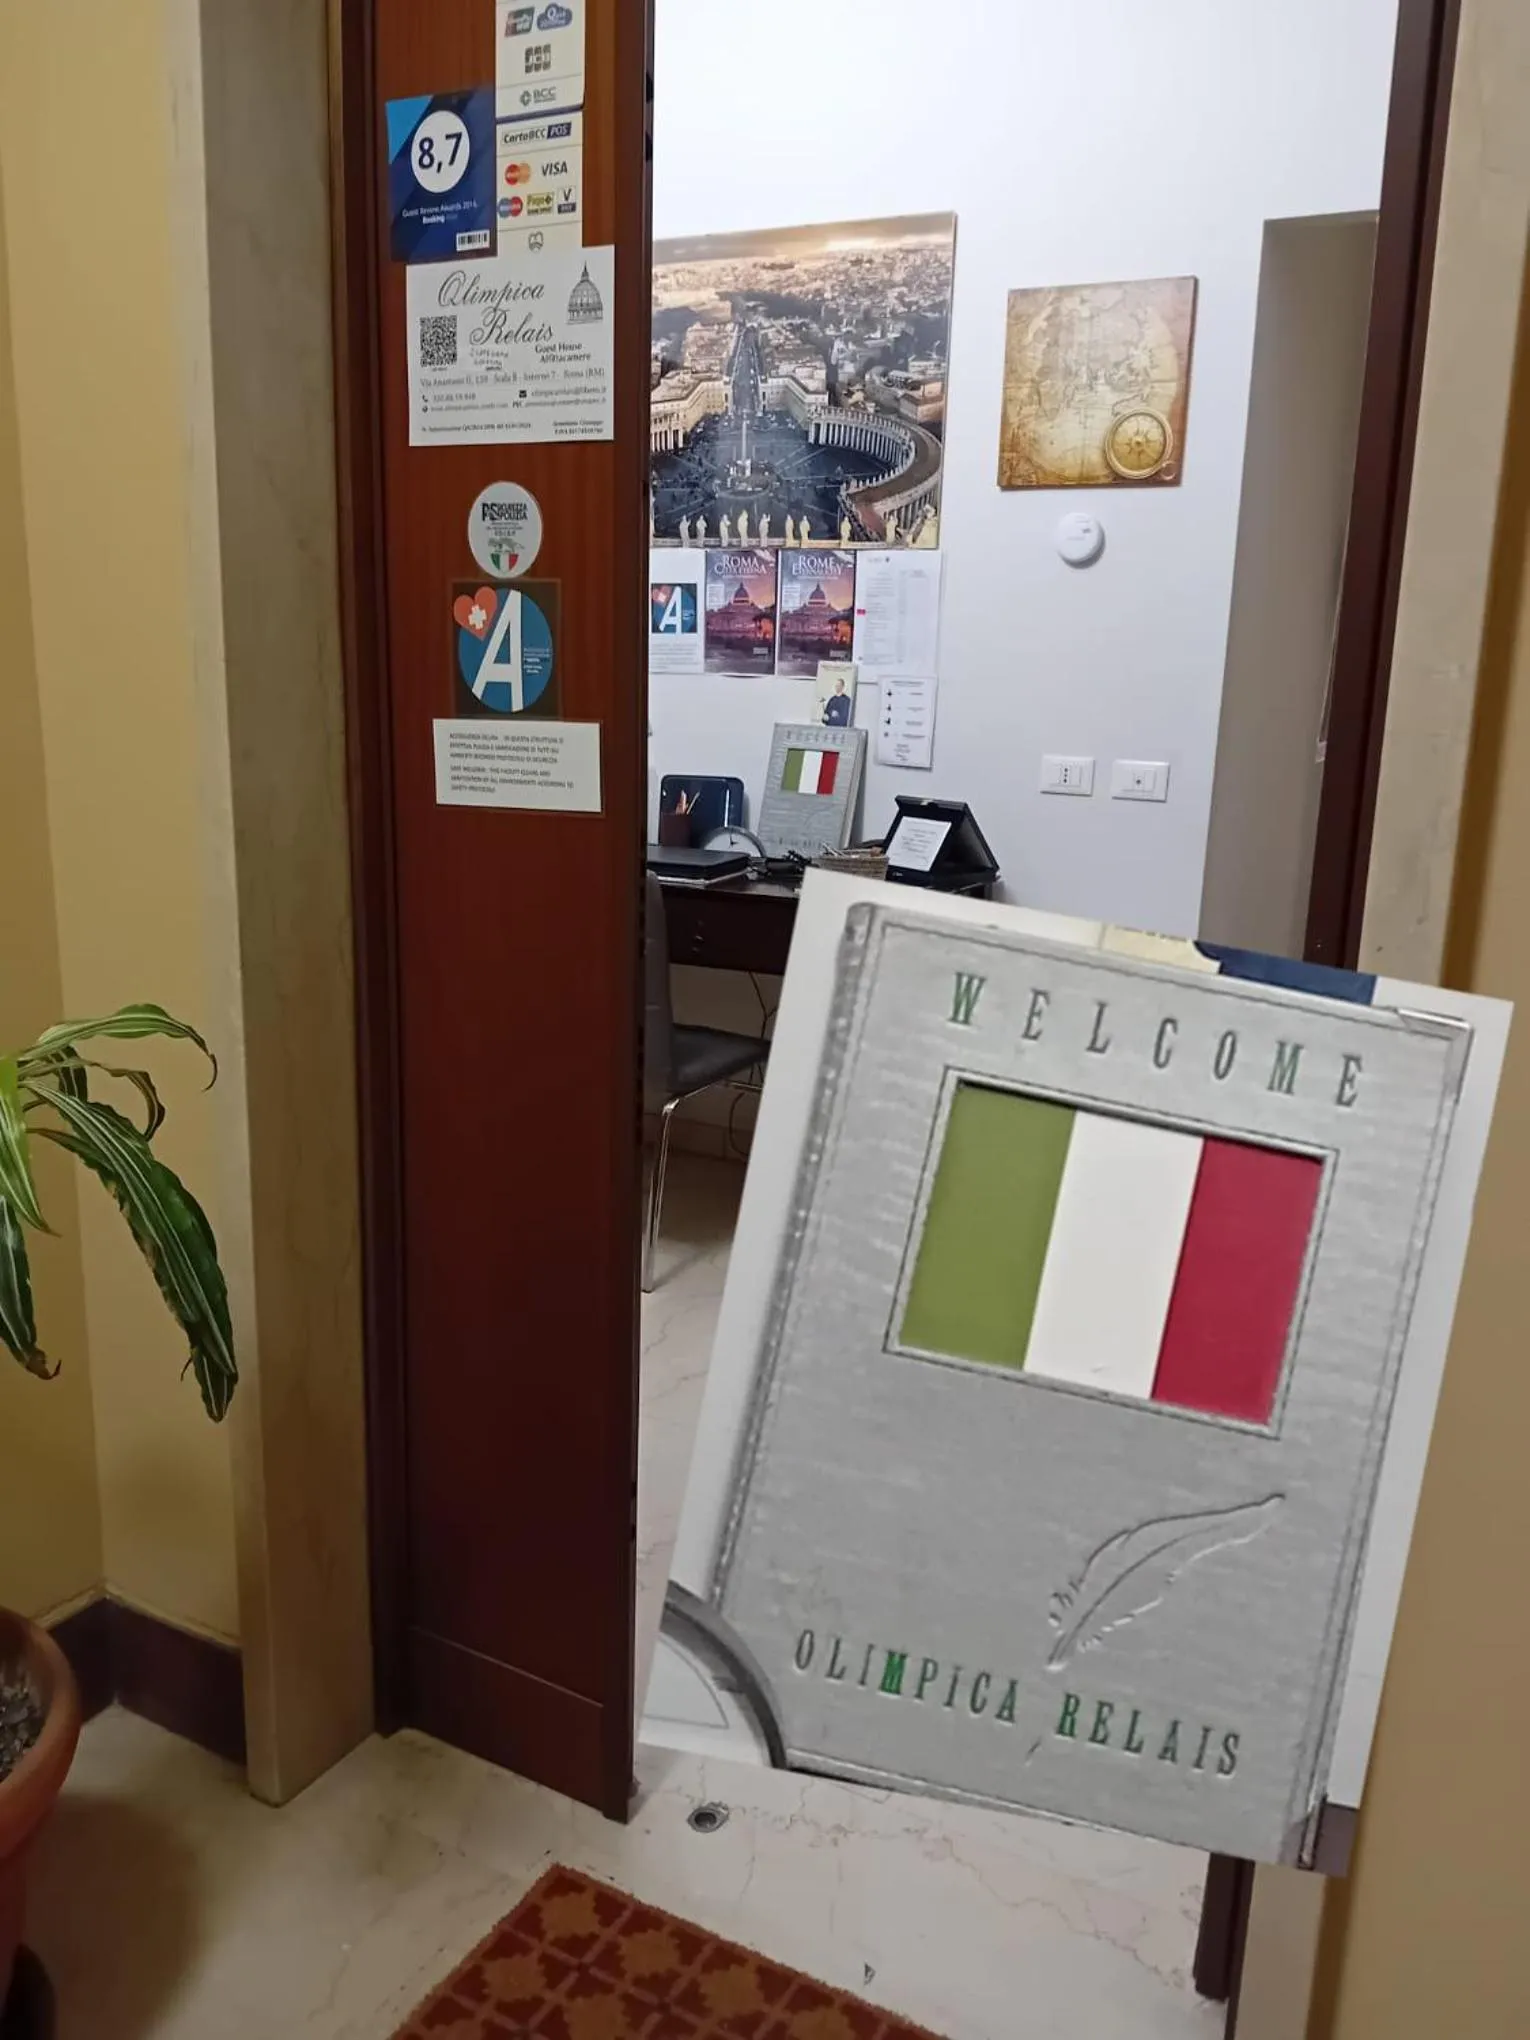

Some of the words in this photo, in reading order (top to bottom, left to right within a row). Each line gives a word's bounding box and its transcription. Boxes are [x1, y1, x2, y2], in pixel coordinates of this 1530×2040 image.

[533, 86, 557, 98] BCC
[418, 132, 463, 173] 8,7
[541, 161, 568, 176] VISA
[438, 270, 545, 309] Olimpica
[469, 306, 553, 345] Relais
[723, 555, 760, 568] ROMA
[948, 970, 1364, 1108] WELCOME
[794, 1628, 1018, 1724] OLIMPICA
[1056, 1693, 1241, 1776] RELAIS
